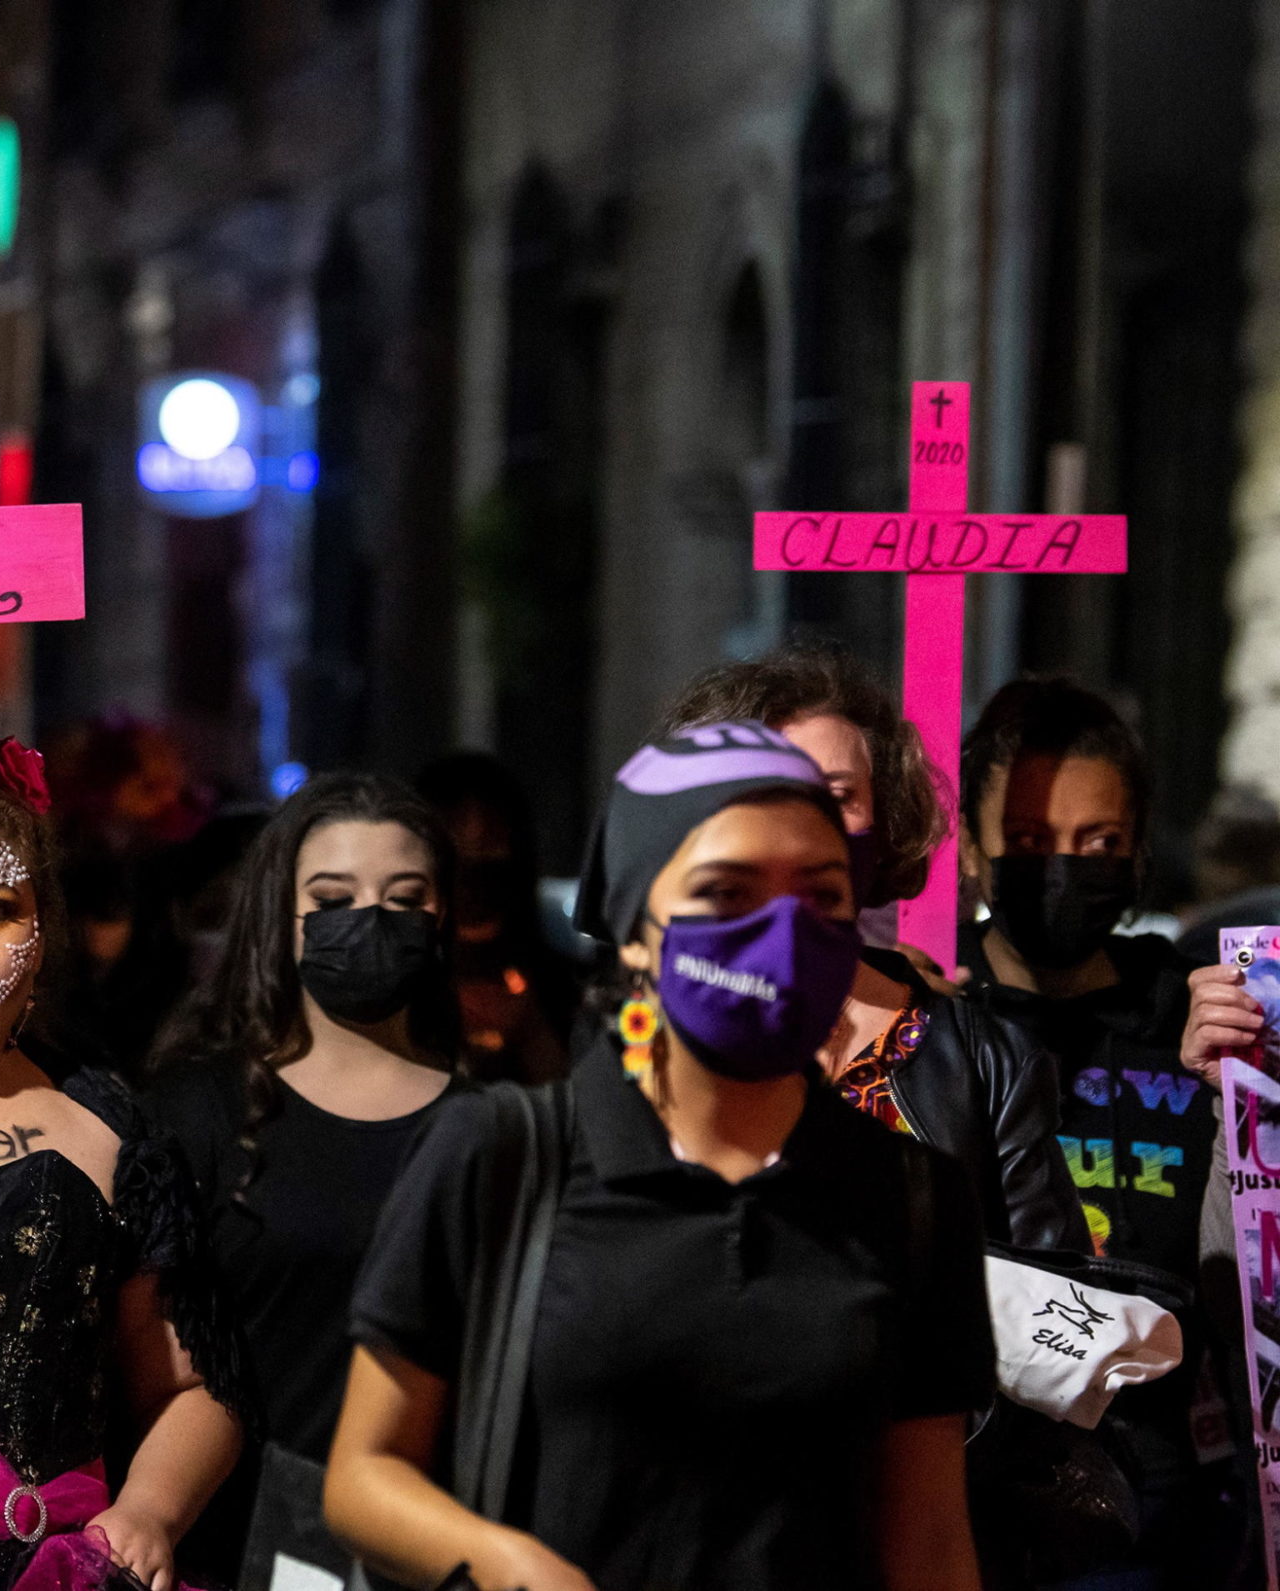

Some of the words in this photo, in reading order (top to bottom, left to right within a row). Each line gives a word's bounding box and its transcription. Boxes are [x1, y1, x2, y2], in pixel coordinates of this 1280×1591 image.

[915, 441, 964, 466] 2020
[780, 518, 1082, 569] CLAUDIA
[1032, 1329, 1087, 1360] Elisa
